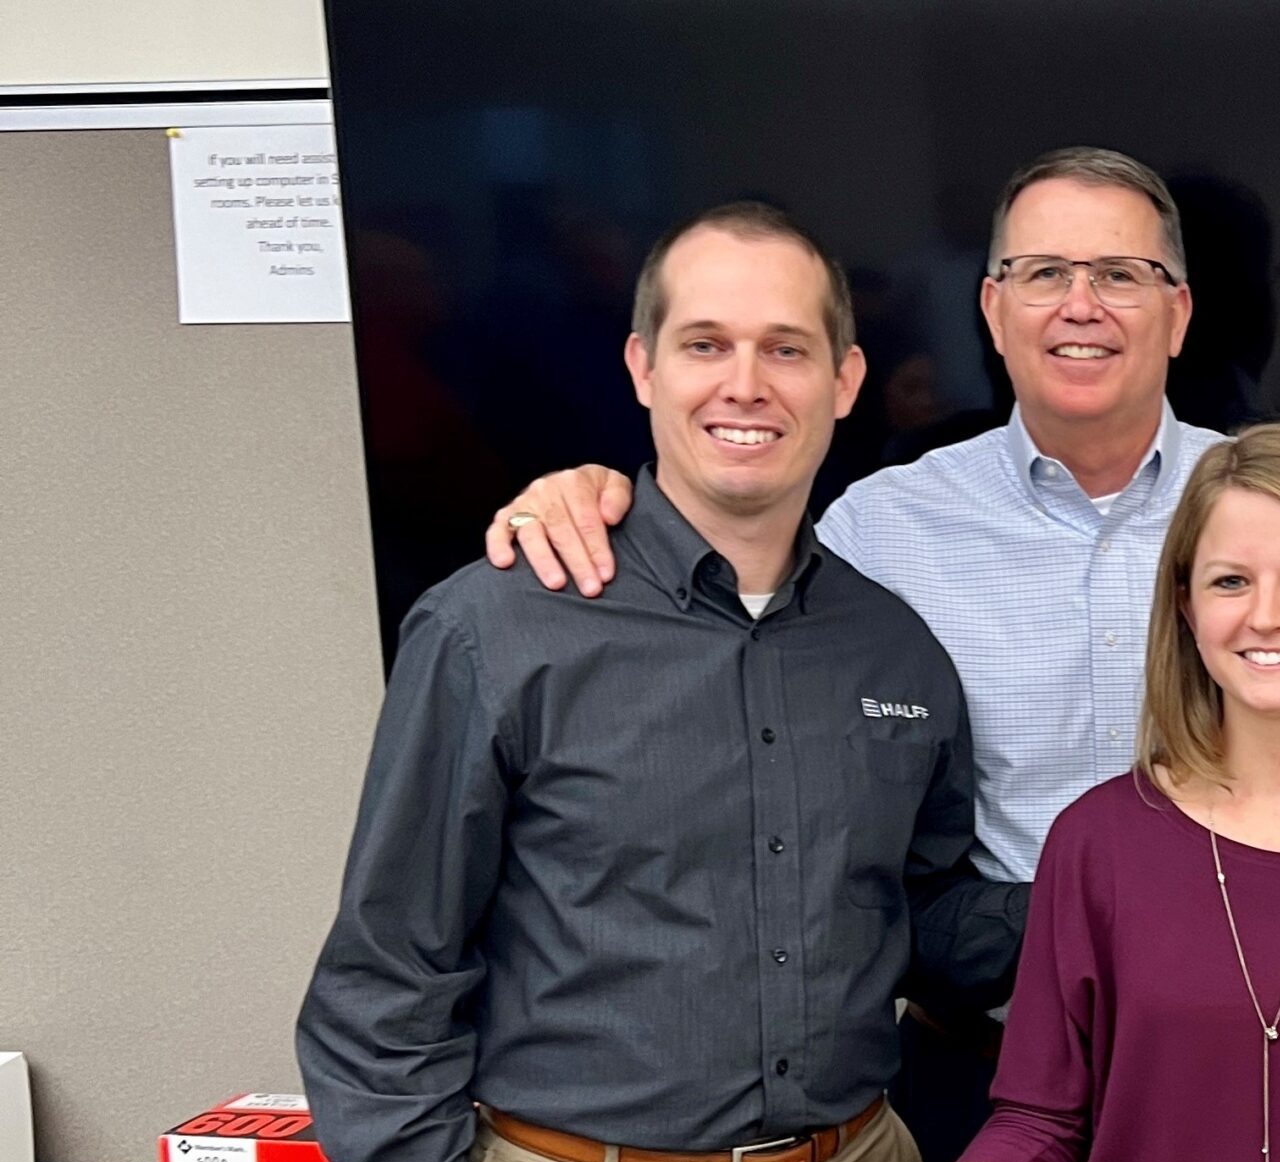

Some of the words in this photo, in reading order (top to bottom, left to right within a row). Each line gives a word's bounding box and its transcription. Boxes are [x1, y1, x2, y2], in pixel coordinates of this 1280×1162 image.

[220, 156, 242, 168] you
[245, 153, 265, 165] will
[267, 153, 298, 165] need
[193, 176, 235, 189] setting
[238, 177, 253, 188] up
[255, 175, 315, 188] computer
[316, 173, 329, 185] in
[255, 196, 294, 208] Please
[296, 195, 313, 207] let
[315, 197, 330, 207] us
[246, 216, 284, 230] ahead
[286, 216, 299, 229] of
[257, 240, 294, 252] Thank
[269, 264, 315, 276] Admins
[177, 1113, 314, 1138] 600
